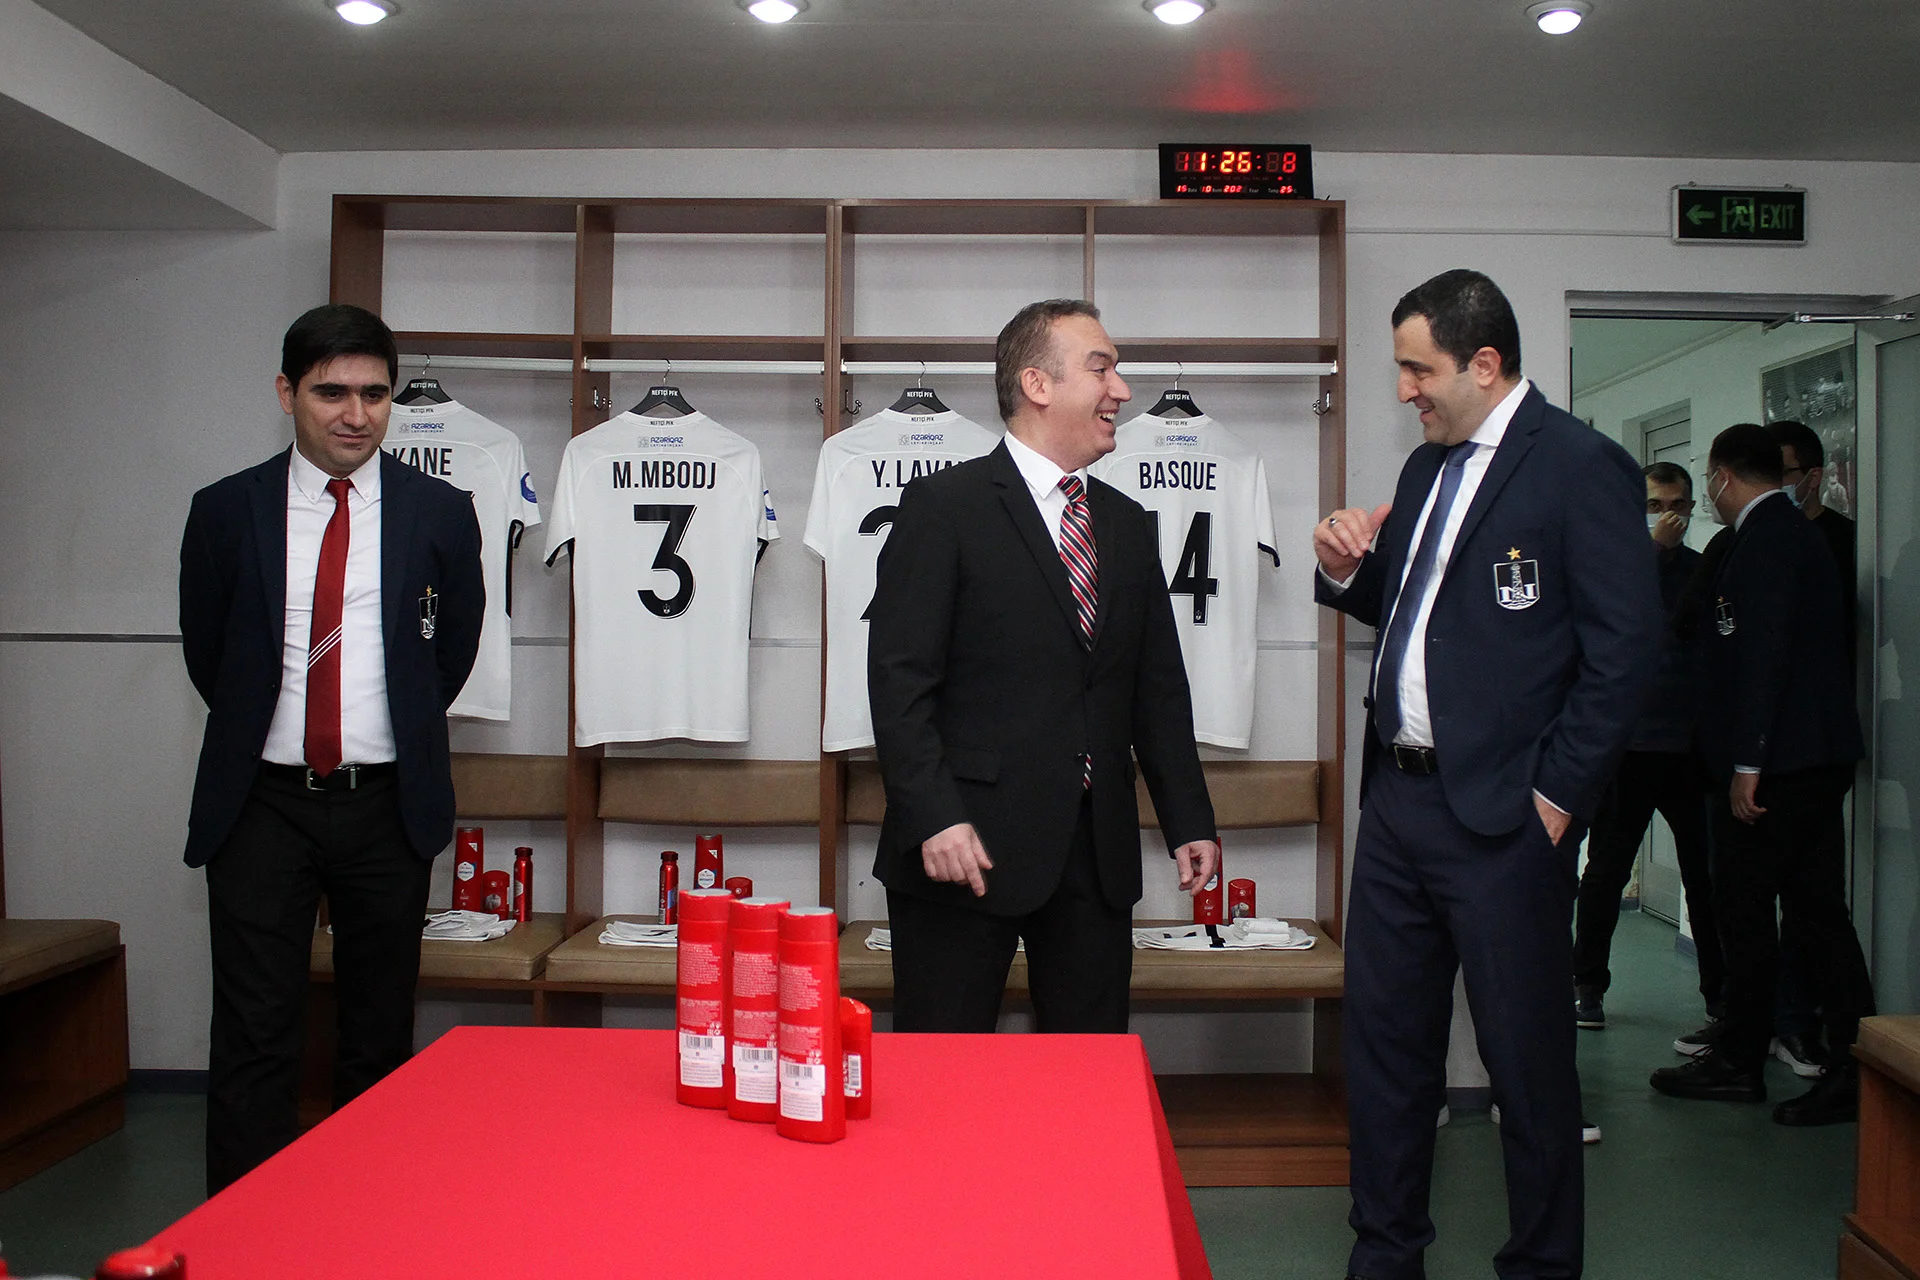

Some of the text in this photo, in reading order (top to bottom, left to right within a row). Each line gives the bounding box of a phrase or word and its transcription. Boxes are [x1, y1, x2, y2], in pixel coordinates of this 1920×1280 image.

[1760, 204, 1796, 229] EXIT
[612, 460, 717, 490] M.MBODJ
[1138, 460, 1217, 491] BASQUE
[633, 503, 697, 619] 3
